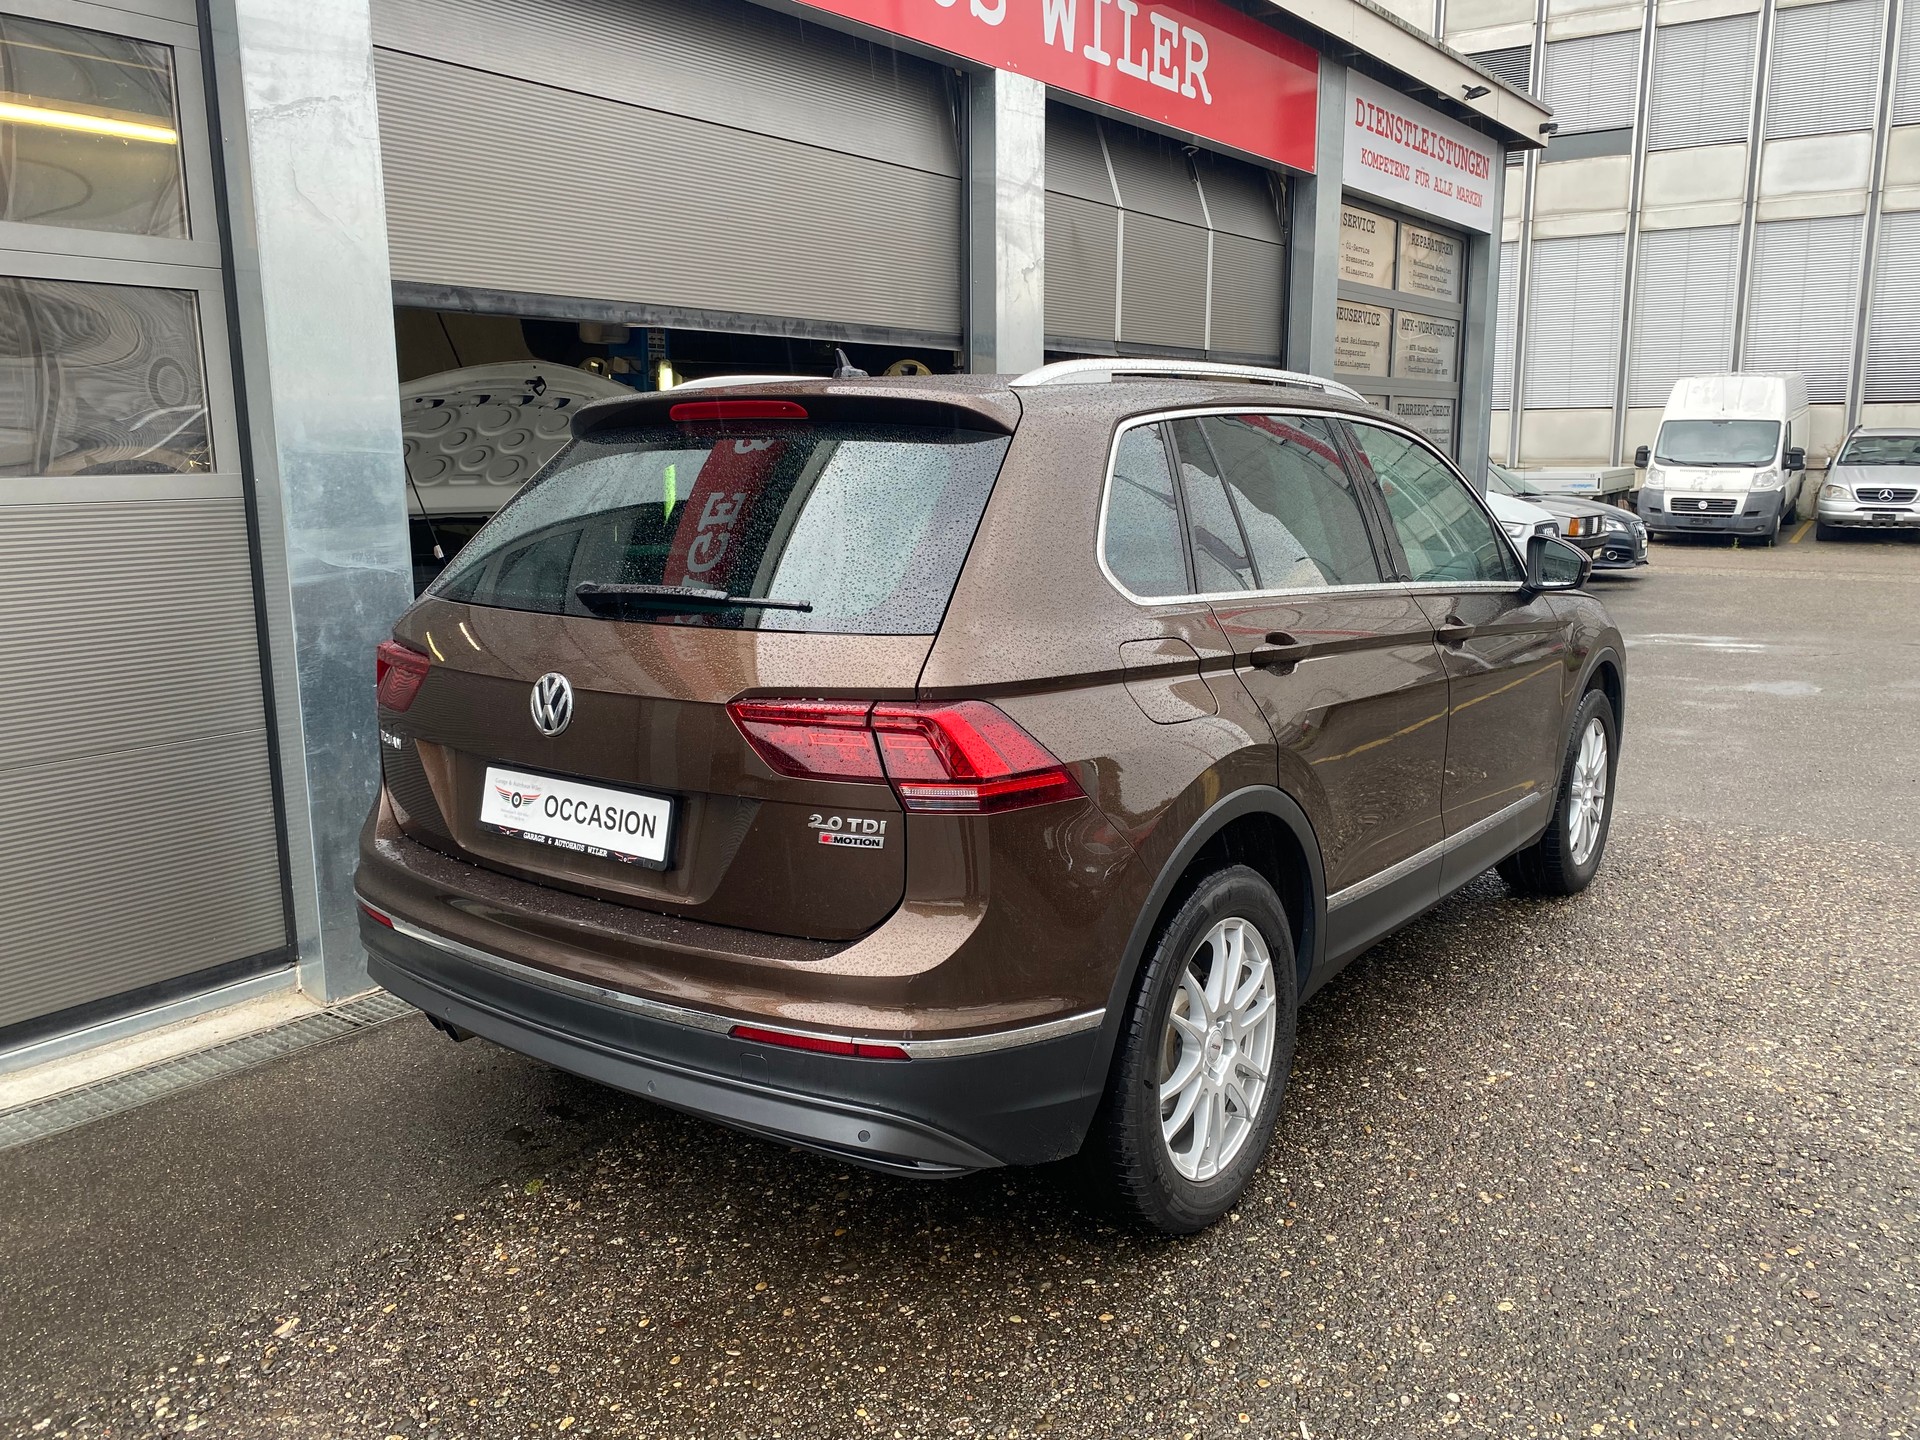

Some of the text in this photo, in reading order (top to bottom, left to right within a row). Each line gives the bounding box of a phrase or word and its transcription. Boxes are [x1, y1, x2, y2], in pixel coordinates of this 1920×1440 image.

[1042, 0, 1212, 104] WILER
[1355, 98, 1490, 180] DIENSTLEISTUNGEN
[1360, 148, 1483, 208] KOMPETENZ FÜR ALLE MARKEN
[1342, 212, 1376, 234] SERVICE
[1411, 232, 1454, 256] REPARATUREN
[1397, 403, 1451, 417] FAHRZEUG-CHECK
[544, 794, 657, 839] OCCASION
[846, 818, 887, 835] TDI
[523, 831, 608, 858] GARAGE & AUTOHAUS WILER
